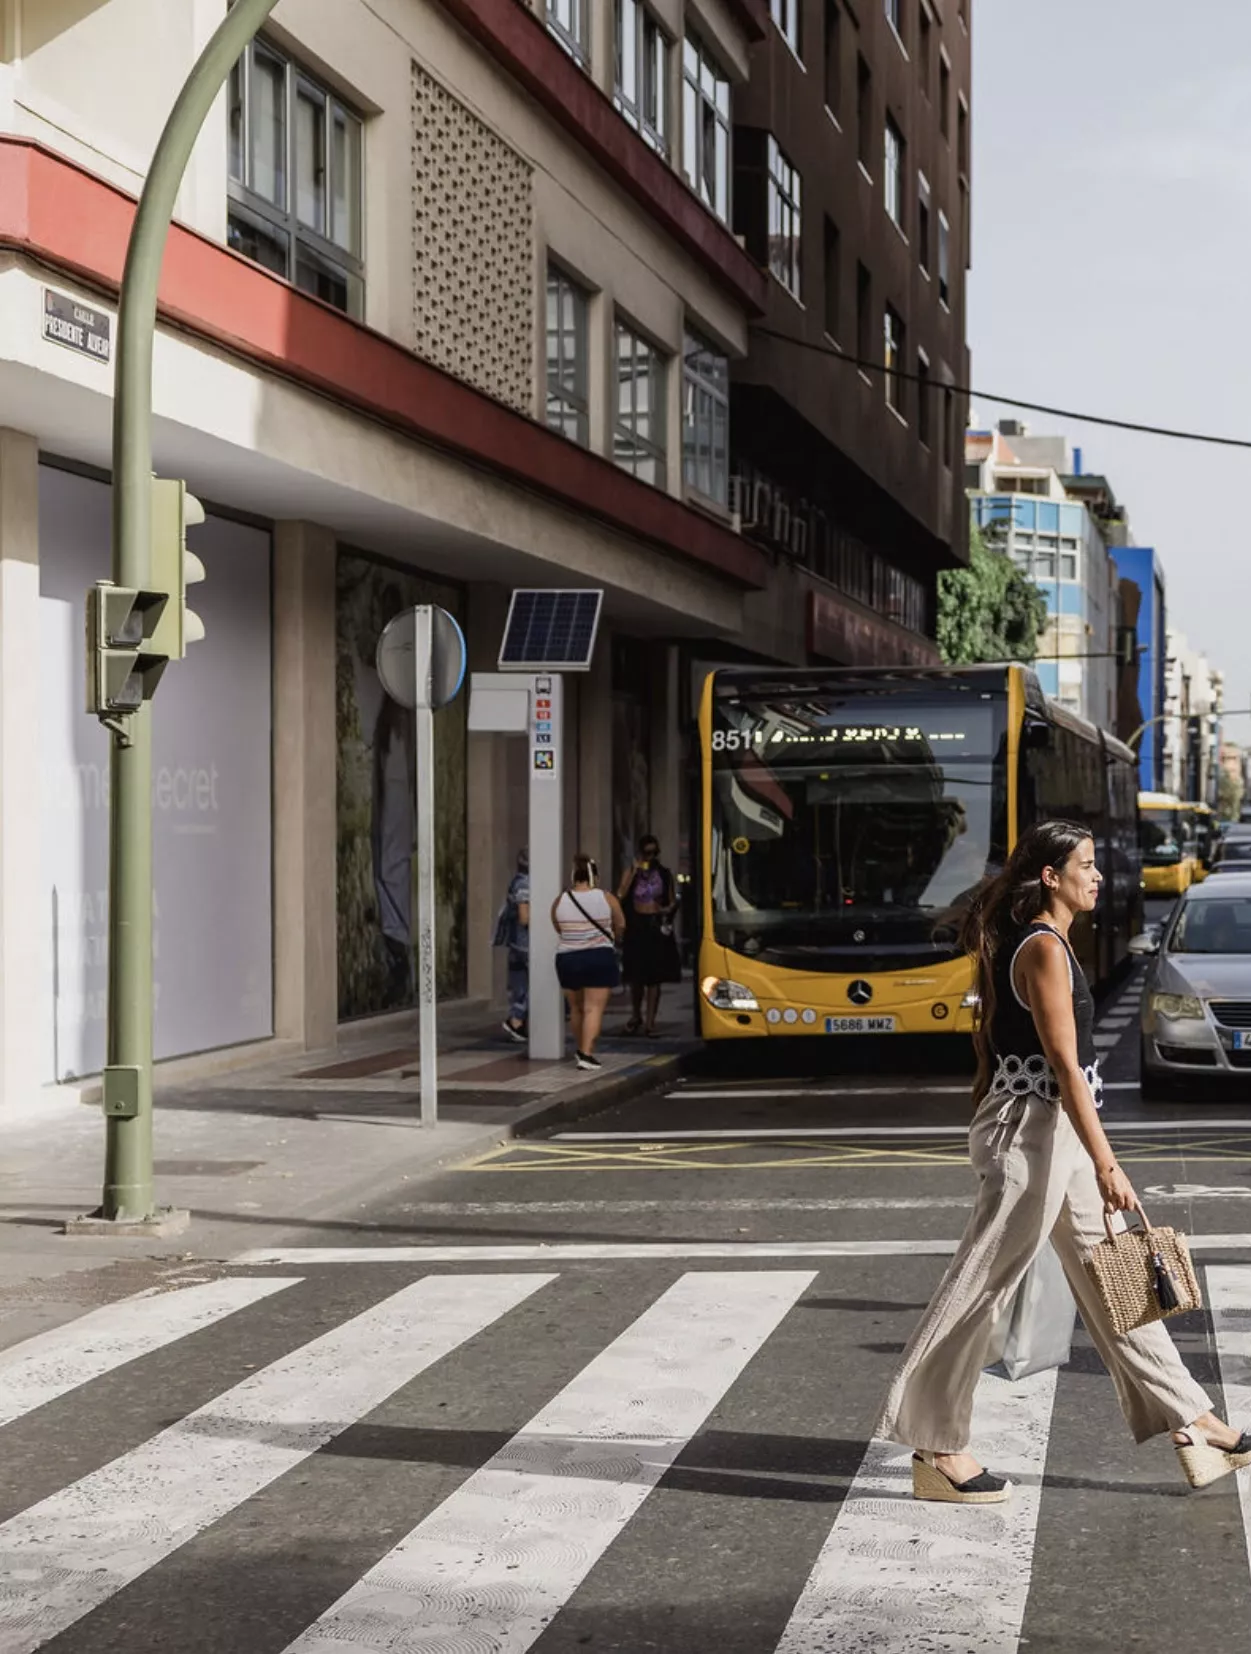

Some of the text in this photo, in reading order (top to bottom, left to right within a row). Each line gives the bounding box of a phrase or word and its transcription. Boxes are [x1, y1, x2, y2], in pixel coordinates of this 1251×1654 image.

[45, 313, 110, 357] PRESIDENTE ALVEAR
[712, 730, 751, 751] 851
